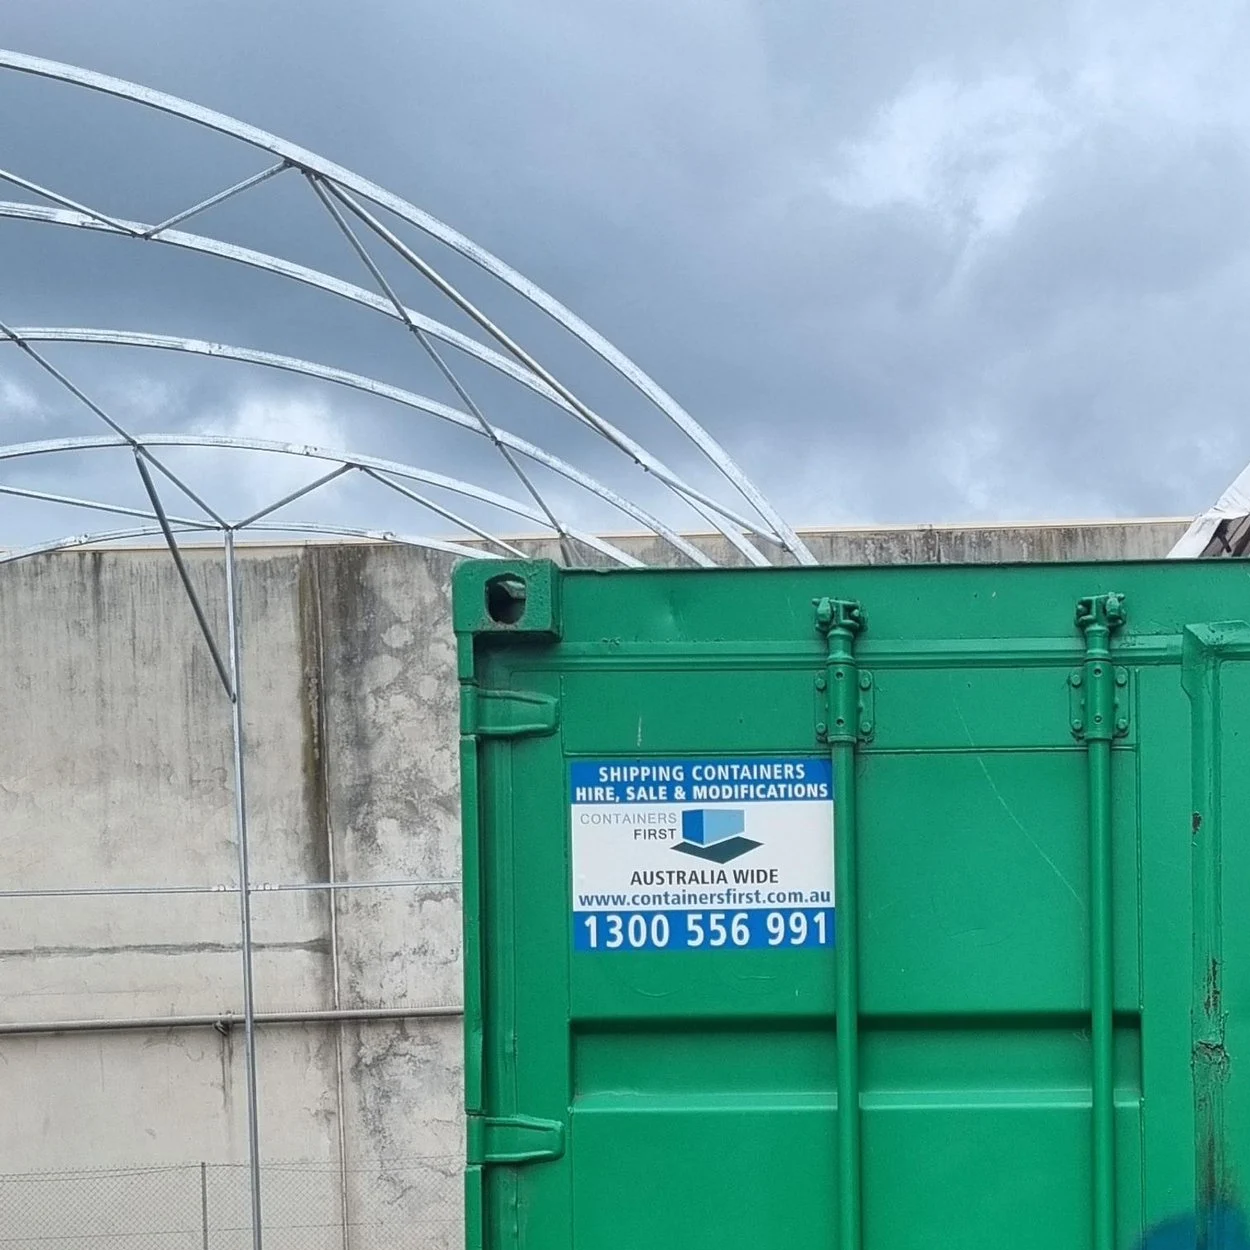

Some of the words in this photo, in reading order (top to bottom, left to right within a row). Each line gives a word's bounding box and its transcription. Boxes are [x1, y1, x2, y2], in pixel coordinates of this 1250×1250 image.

[599, 765, 684, 782] SHIPPING
[692, 763, 805, 781] CONTAINERS
[576, 787, 620, 802] HIRE,
[626, 786, 667, 801] SALE
[674, 785, 686, 800] &
[692, 783, 828, 800] MODIFICATIONS
[580, 812, 677, 825] CONTAINERS
[633, 828, 677, 840] FIRST
[630, 869, 728, 886] AUSTRALIA
[732, 868, 779, 884] WIDE
[578, 888, 831, 907] www.containersfirst.com.au
[584, 914, 670, 948] 1300
[687, 912, 750, 946] 556
[767, 911, 826, 945] 991
